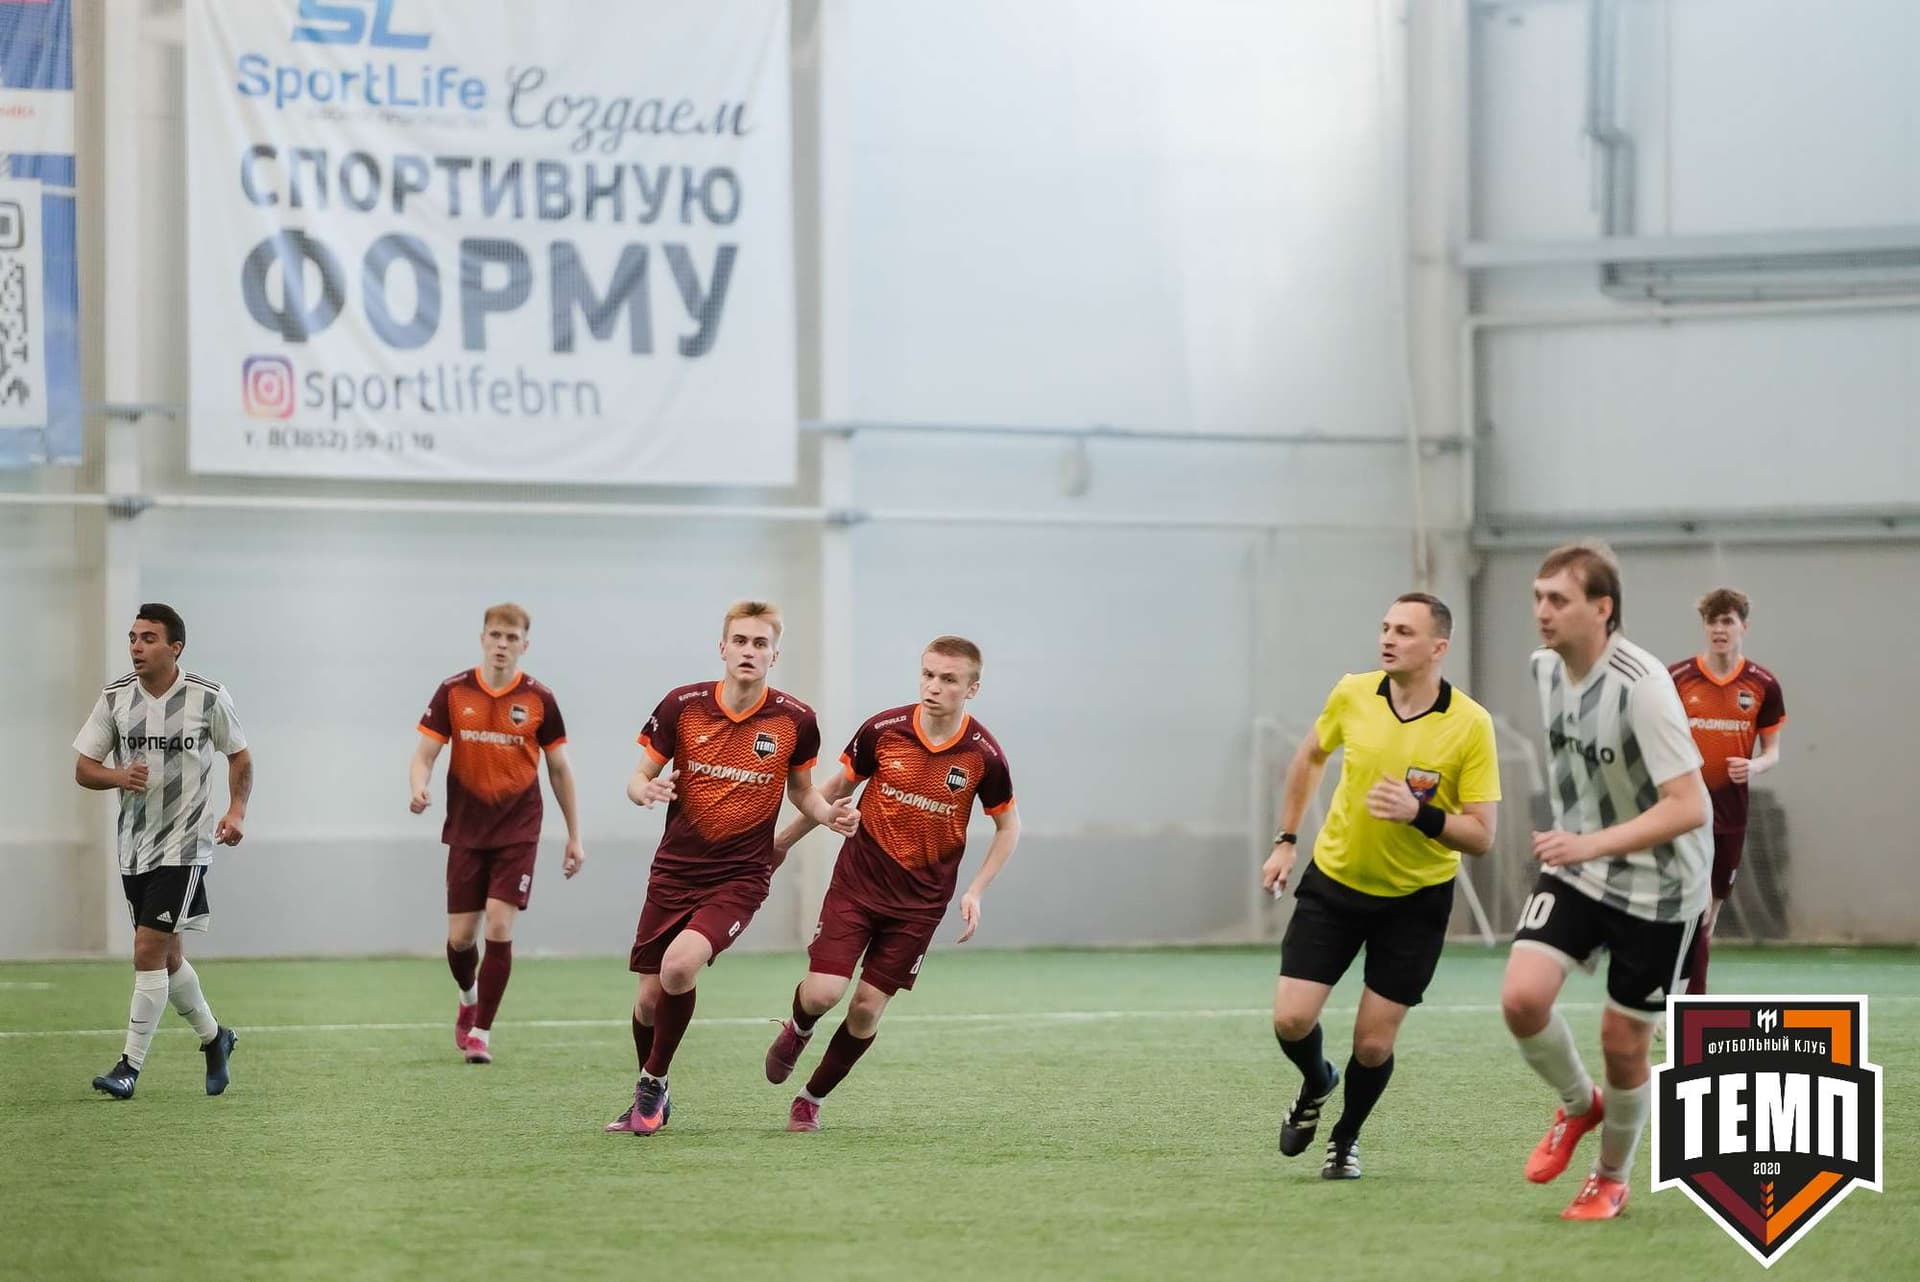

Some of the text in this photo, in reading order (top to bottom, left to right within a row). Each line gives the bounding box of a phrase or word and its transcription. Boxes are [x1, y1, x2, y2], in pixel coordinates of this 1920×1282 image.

[236, 53, 488, 111] SportLife
[504, 65, 754, 154] Создаем
[239, 143, 744, 227] СПОРТИВНУЮ
[240, 227, 740, 358] ФОРМУ
[303, 364, 603, 421] sportlifebrn
[121, 736, 195, 752] ТОРПЕДО
[688, 760, 774, 784] ПРОДИНВЕСТ
[755, 740, 776, 754] ТЕМП
